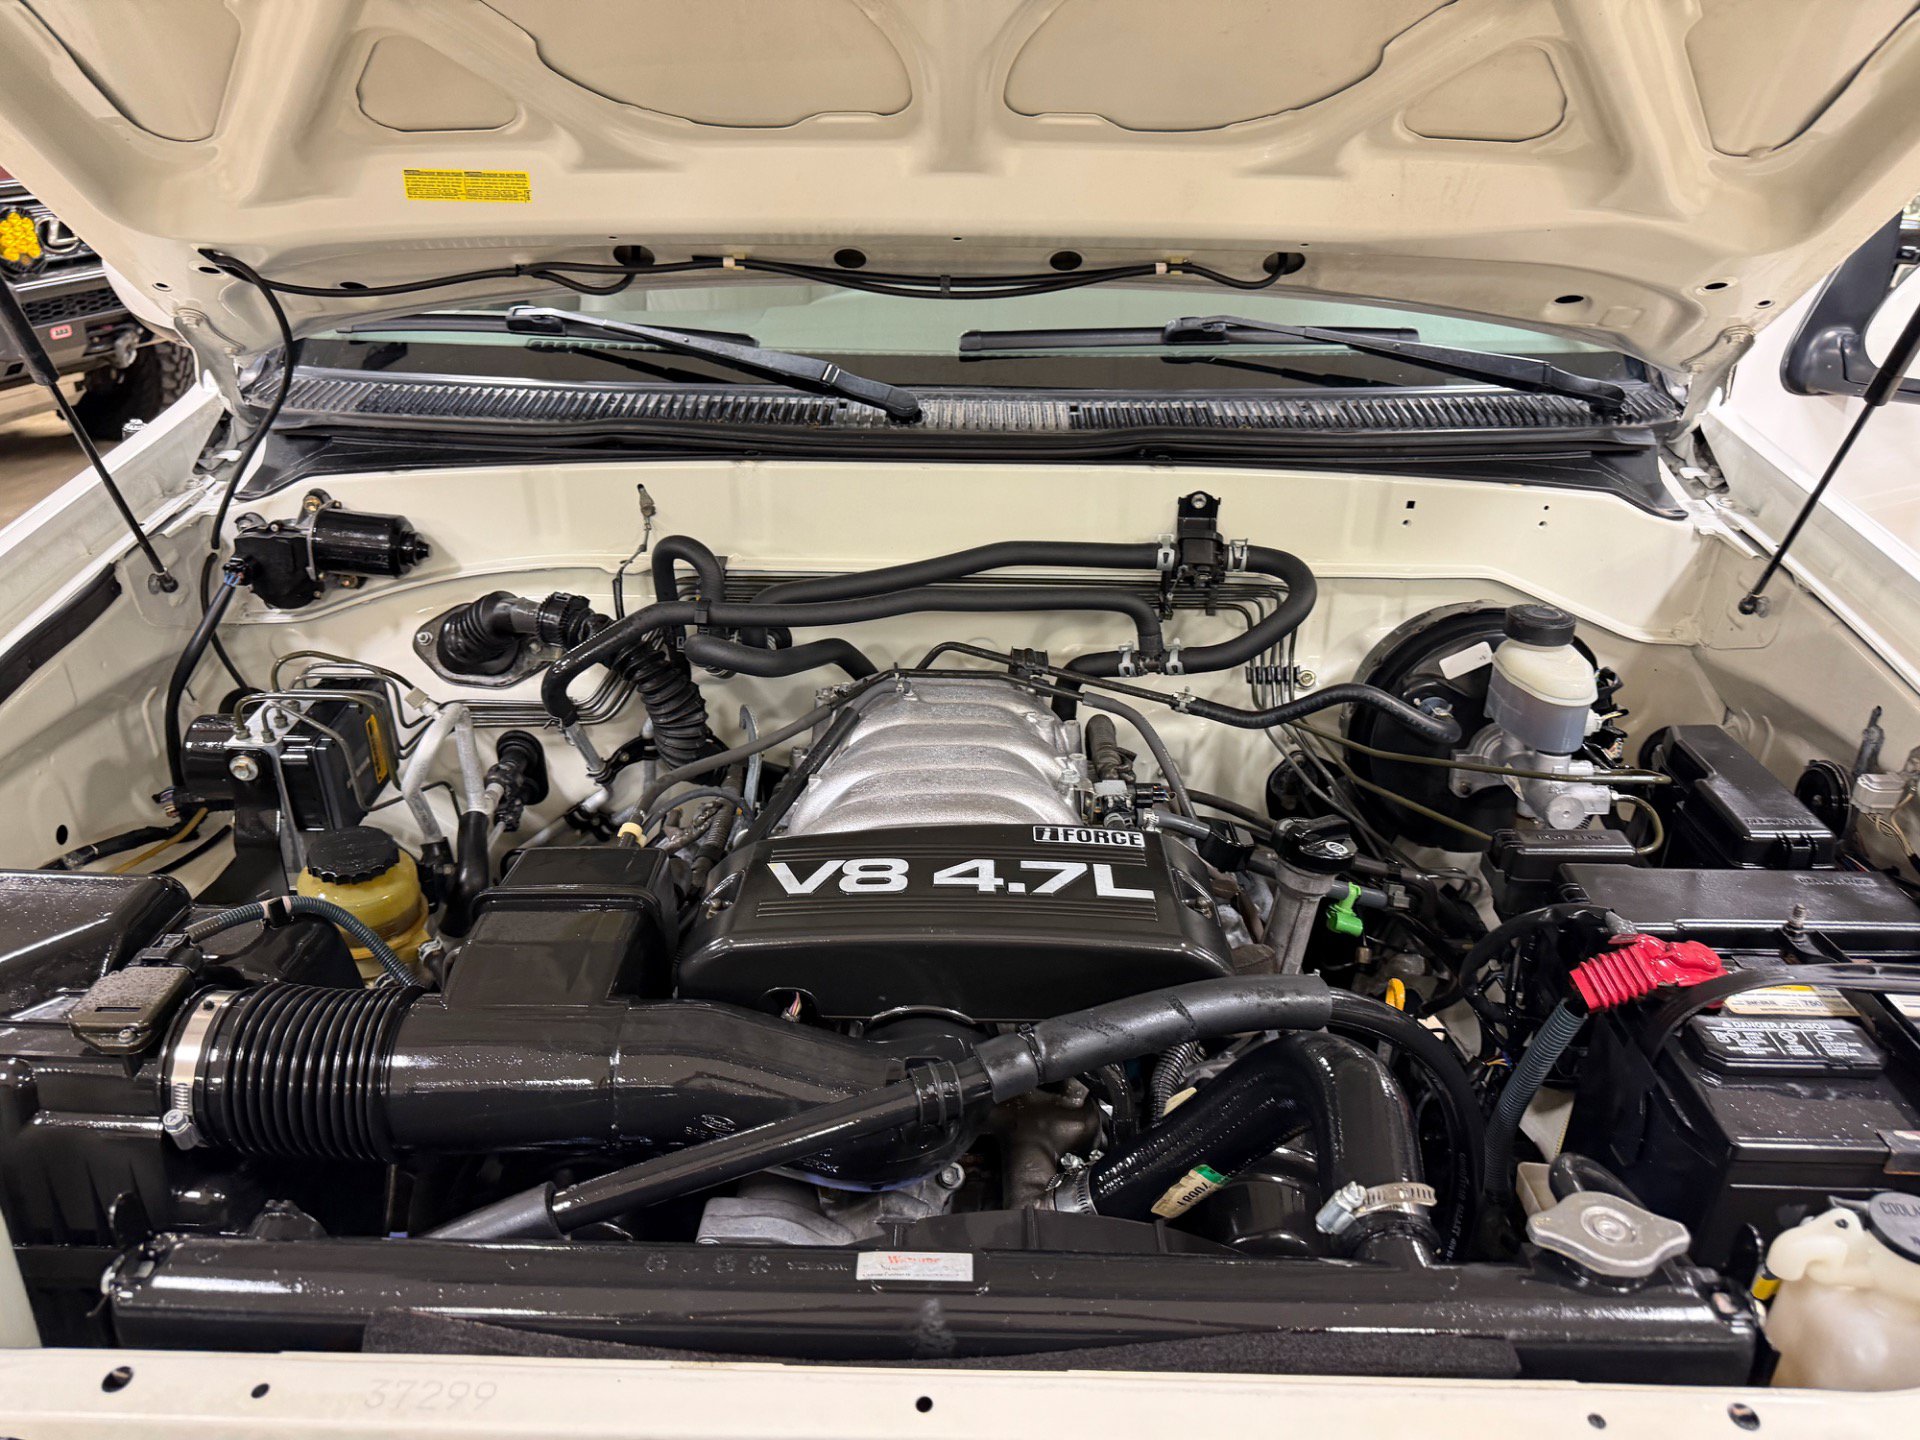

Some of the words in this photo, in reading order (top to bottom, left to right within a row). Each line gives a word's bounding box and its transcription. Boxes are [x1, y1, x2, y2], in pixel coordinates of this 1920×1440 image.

[766, 858, 909, 896] V8
[933, 859, 1156, 900] 4.7L
[1731, 1021, 1777, 1030] DANGER
[1789, 1022, 1831, 1030] POISON
[363, 1378, 498, 1411] 37299
